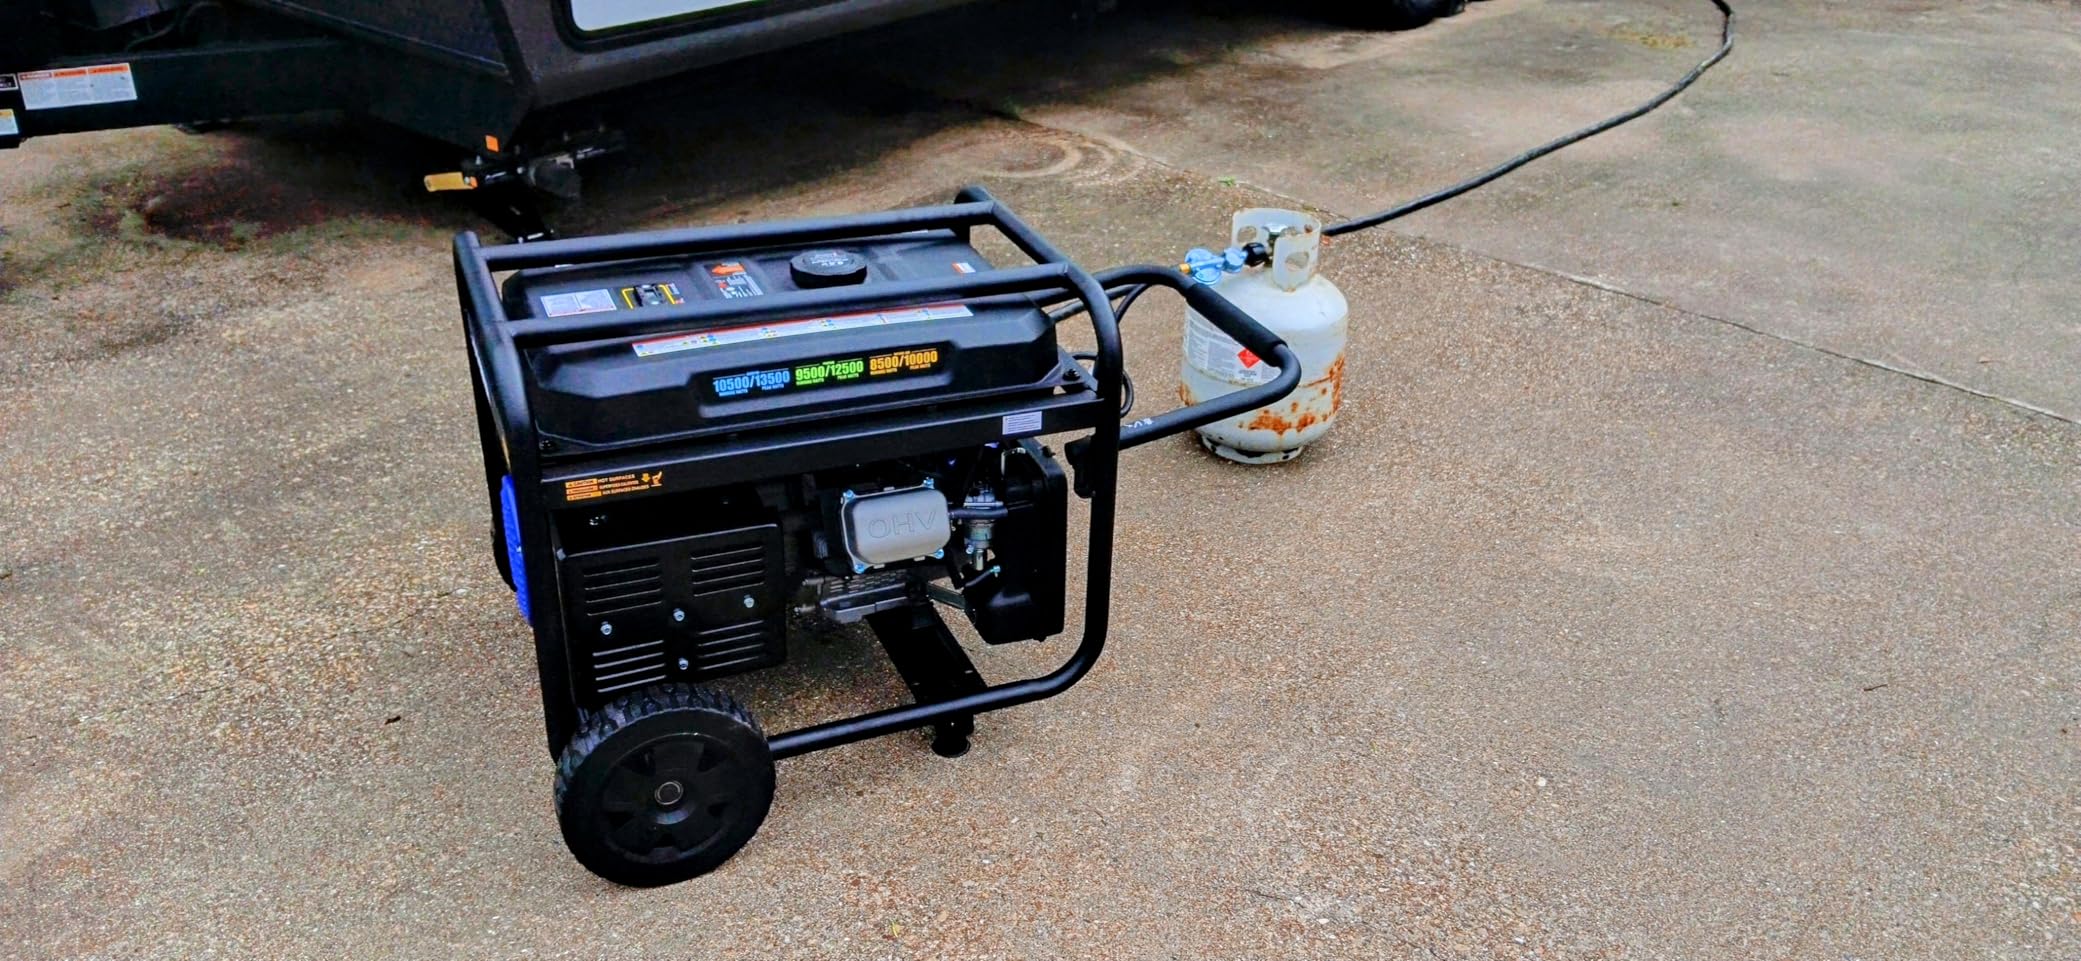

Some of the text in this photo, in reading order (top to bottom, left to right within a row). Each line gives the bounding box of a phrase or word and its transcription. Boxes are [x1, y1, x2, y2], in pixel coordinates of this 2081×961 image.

[795, 360, 864, 382] 9500/12500
[870, 351, 938, 371] 8500/10000
[712, 370, 791, 393] 10500/13500
[868, 511, 937, 539] OHV
